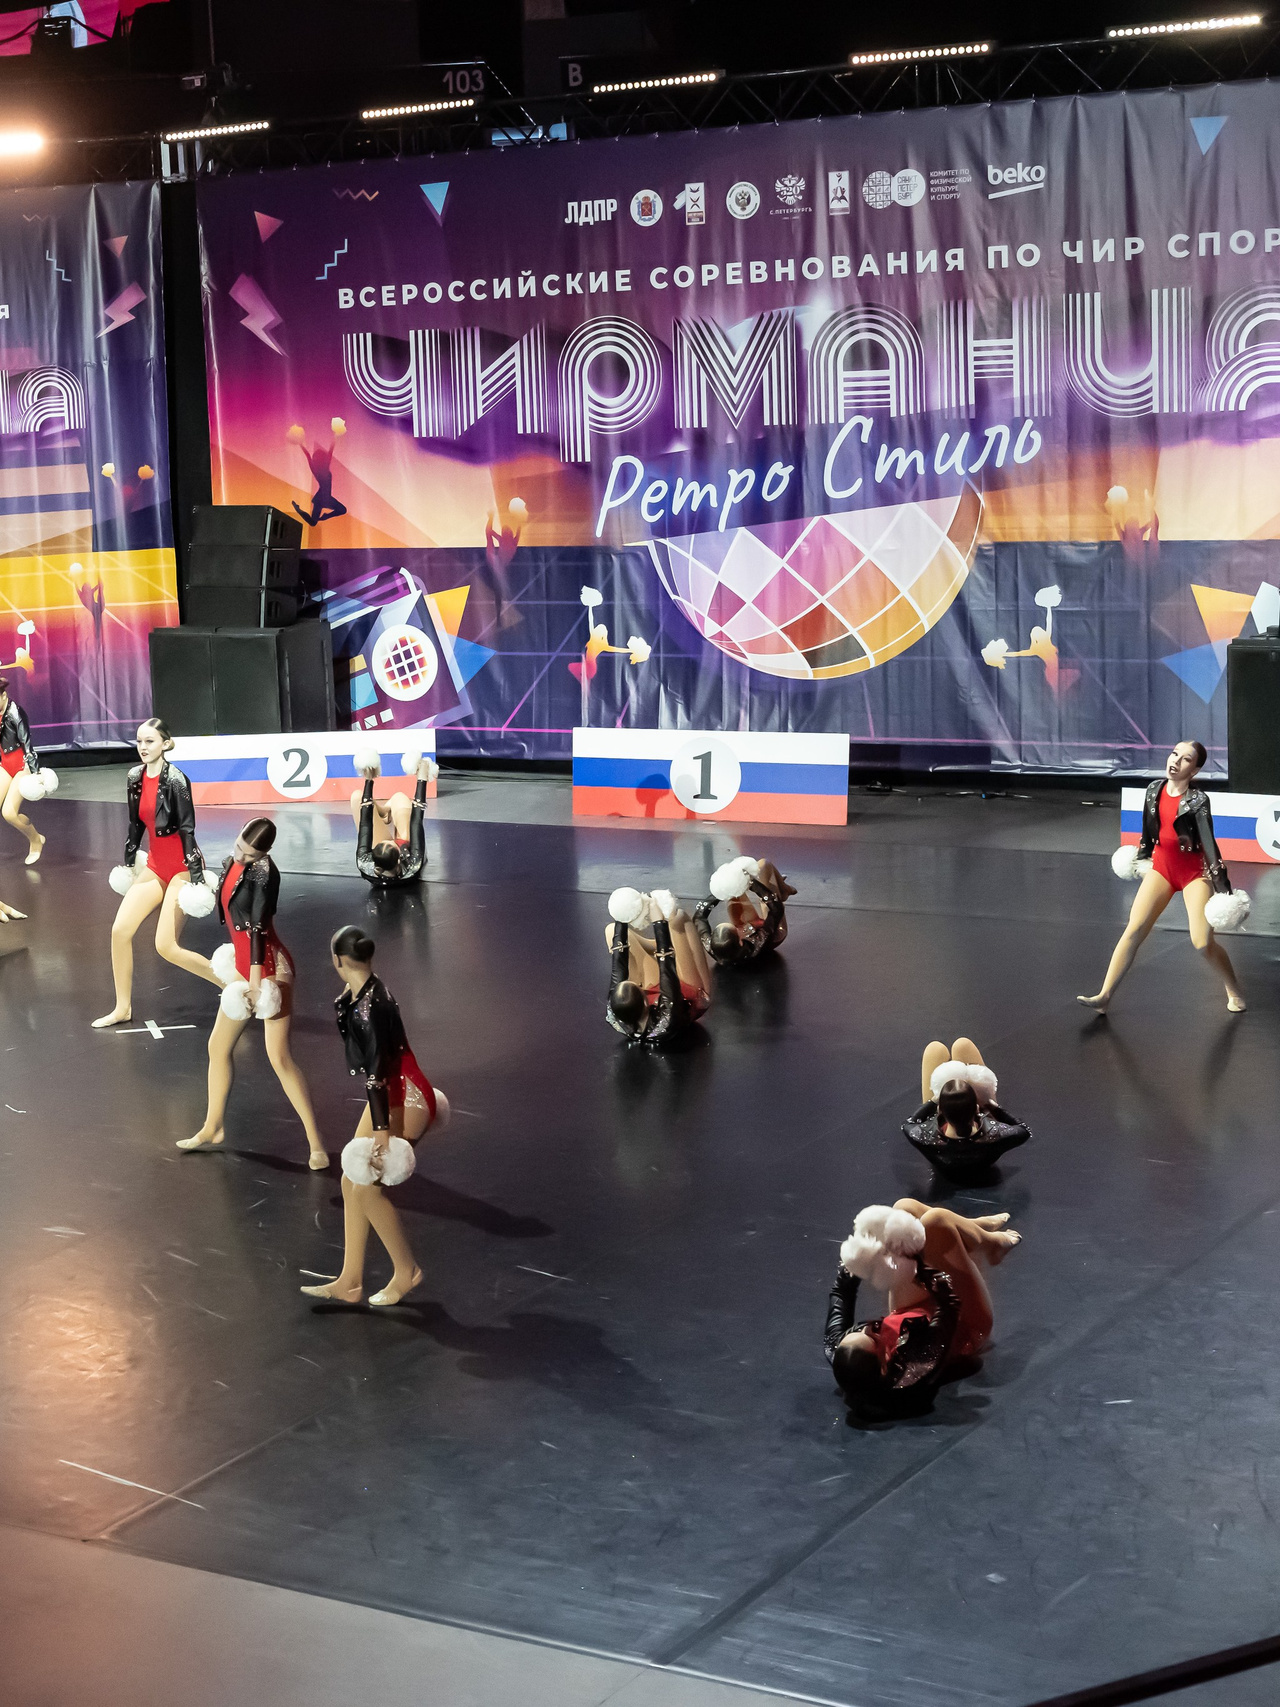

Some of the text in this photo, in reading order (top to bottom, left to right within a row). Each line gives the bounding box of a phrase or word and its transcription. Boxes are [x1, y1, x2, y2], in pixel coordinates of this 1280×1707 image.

[442, 69, 485, 95] 103
[929, 168, 970, 177] КОМИТЕТ ПО
[929, 175, 972, 185] ФИЗИЧЕСКОЙ
[987, 162, 1046, 185] beko
[930, 185, 959, 193] КУЛЬТУРЕ
[564, 199, 618, 226] ЛДПР
[337, 228, 1280, 309] ВСЕРОССИЙСКИЕ СОРЕВНОВАНИЯ ПО ЧИР СПОР
[595, 414, 1042, 538] Ретро Стиль
[282, 747, 312, 788] 2
[692, 750, 718, 800] 1
